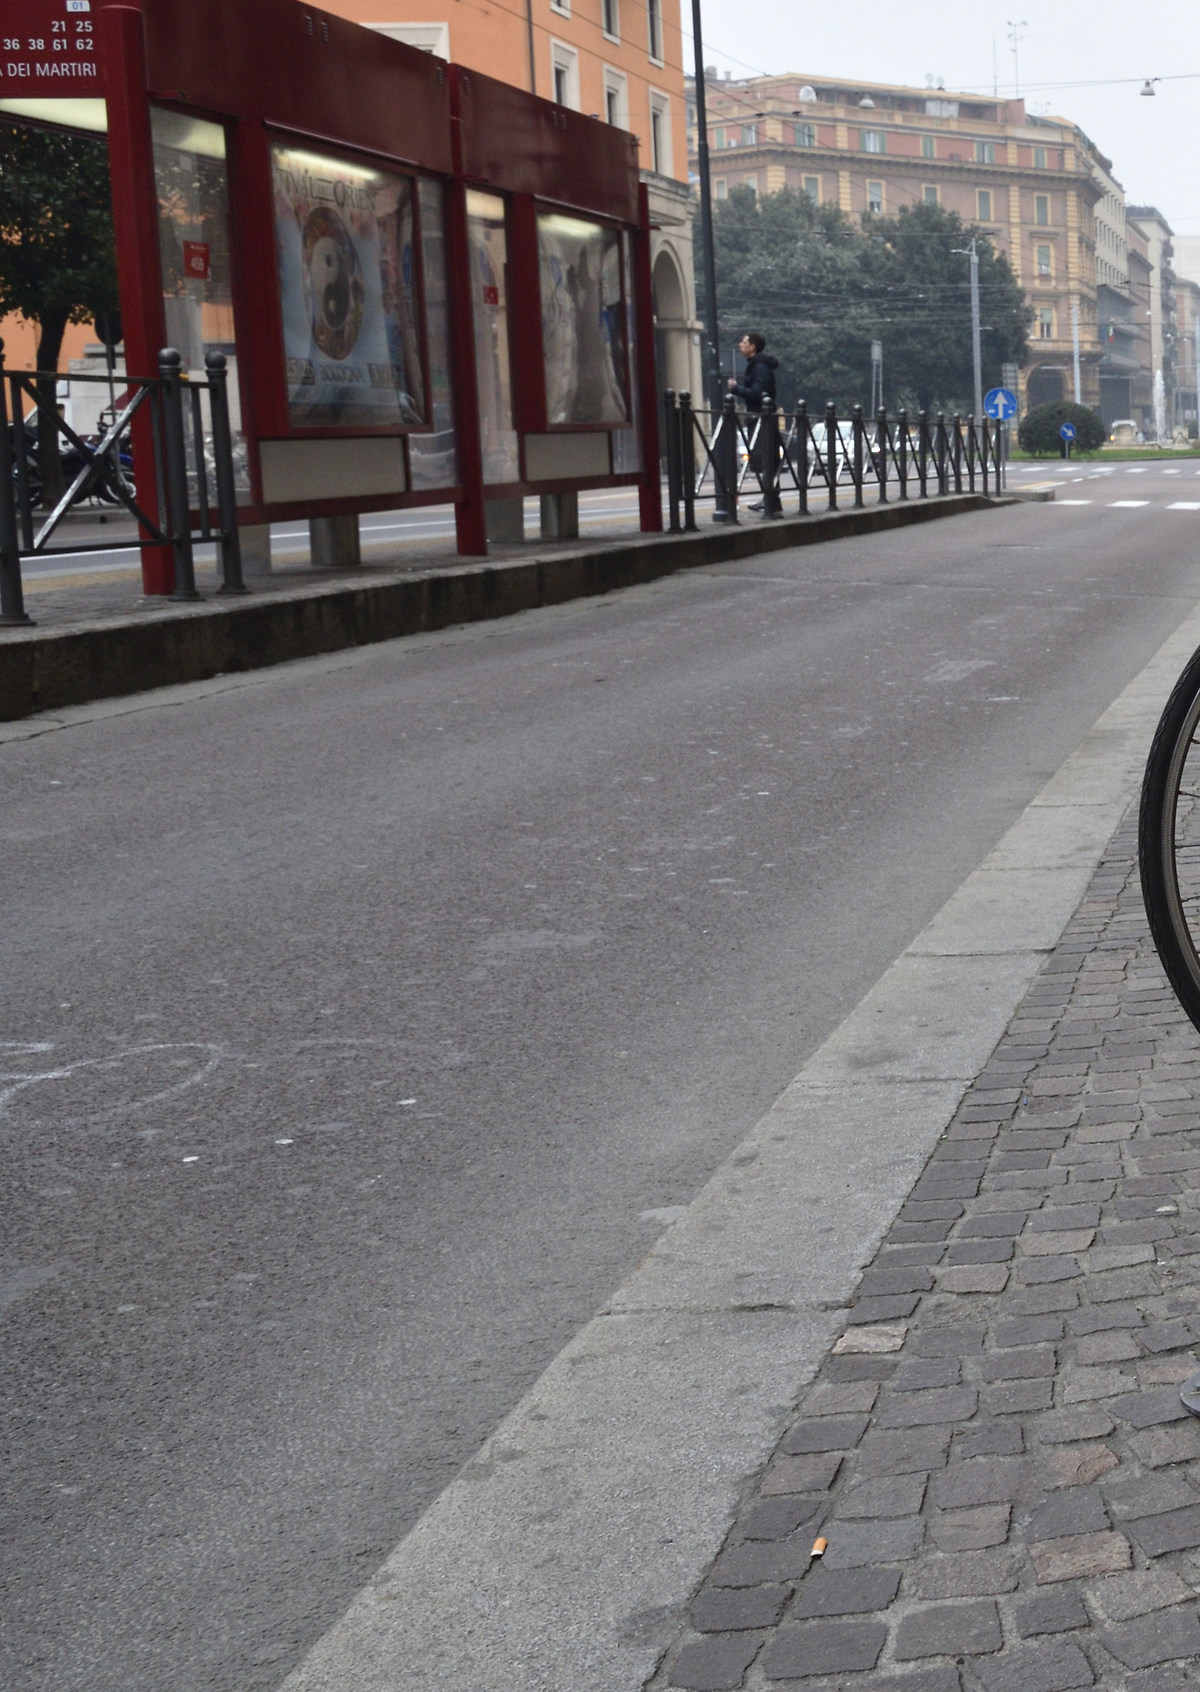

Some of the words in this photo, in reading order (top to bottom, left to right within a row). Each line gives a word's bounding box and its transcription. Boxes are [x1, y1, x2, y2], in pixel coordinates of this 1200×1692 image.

[51, 20, 66, 32] 21
[76, 20, 93, 32] 25
[3, 38, 20, 50] 36
[28, 38, 45, 50] 38
[53, 38, 67, 50] 61
[76, 38, 94, 50] 62
[7, 62, 30, 77] DEI
[35, 62, 97, 77] MARTIRI
